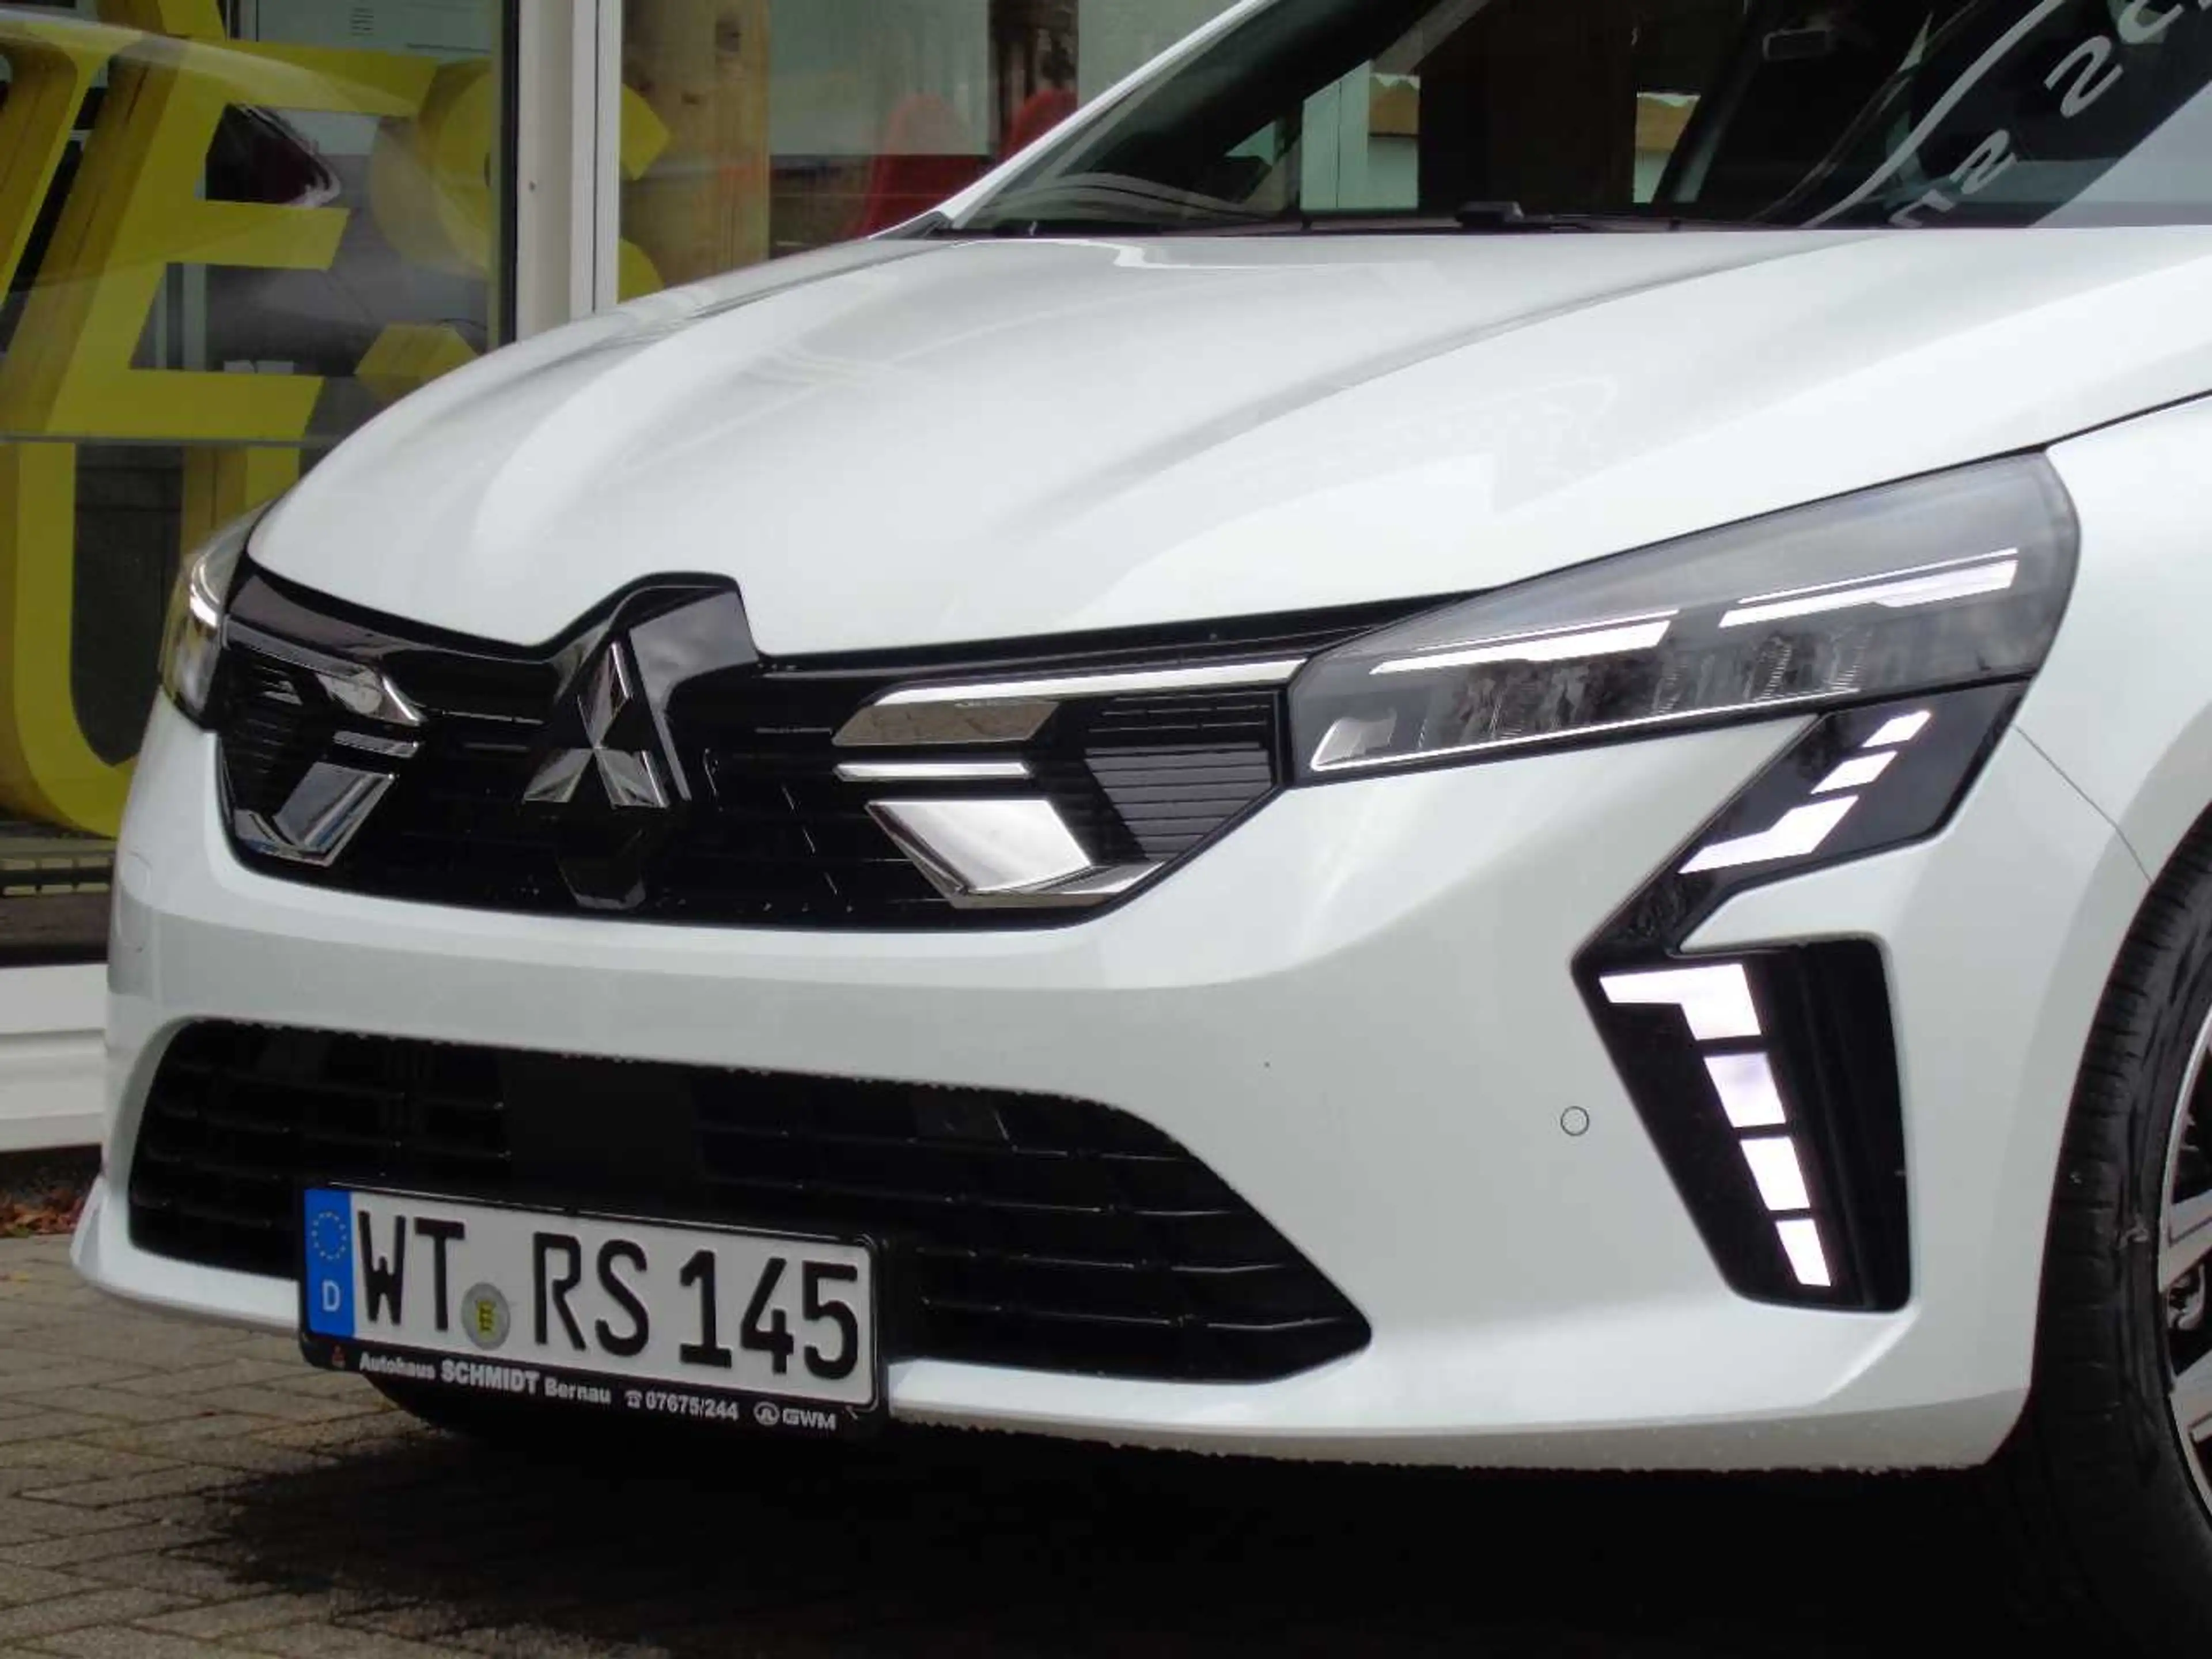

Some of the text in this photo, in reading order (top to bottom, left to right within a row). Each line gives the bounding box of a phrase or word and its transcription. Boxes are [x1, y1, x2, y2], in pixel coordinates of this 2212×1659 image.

[322, 1279, 341, 1312] D
[358, 1210, 858, 1380] WT RS 145
[359, 1351, 837, 1430] Autohaus SCHMIDT Bernau 07675/244 GWM
